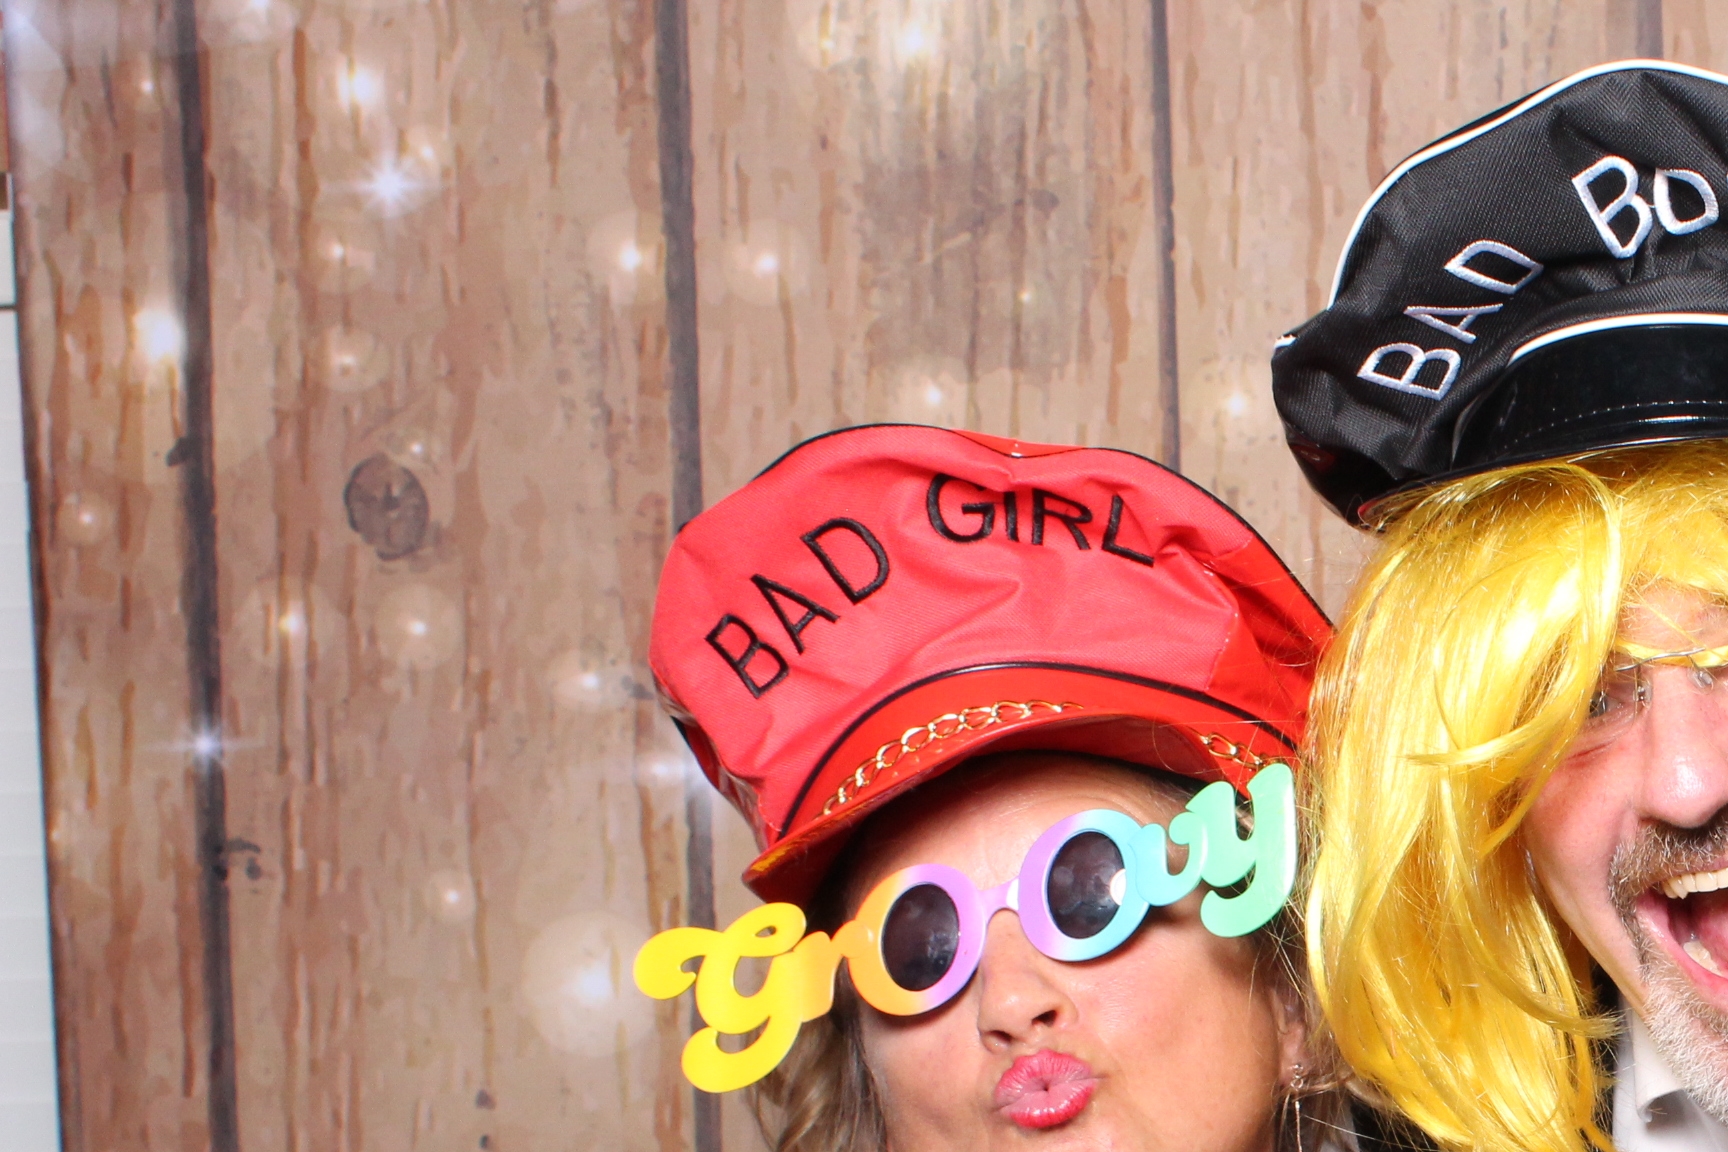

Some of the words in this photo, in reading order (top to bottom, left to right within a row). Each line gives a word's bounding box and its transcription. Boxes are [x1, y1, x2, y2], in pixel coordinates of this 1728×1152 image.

[1357, 239, 1543, 399] BAD
[705, 516, 891, 698] BAD
[926, 473, 1155, 567] GIRL
